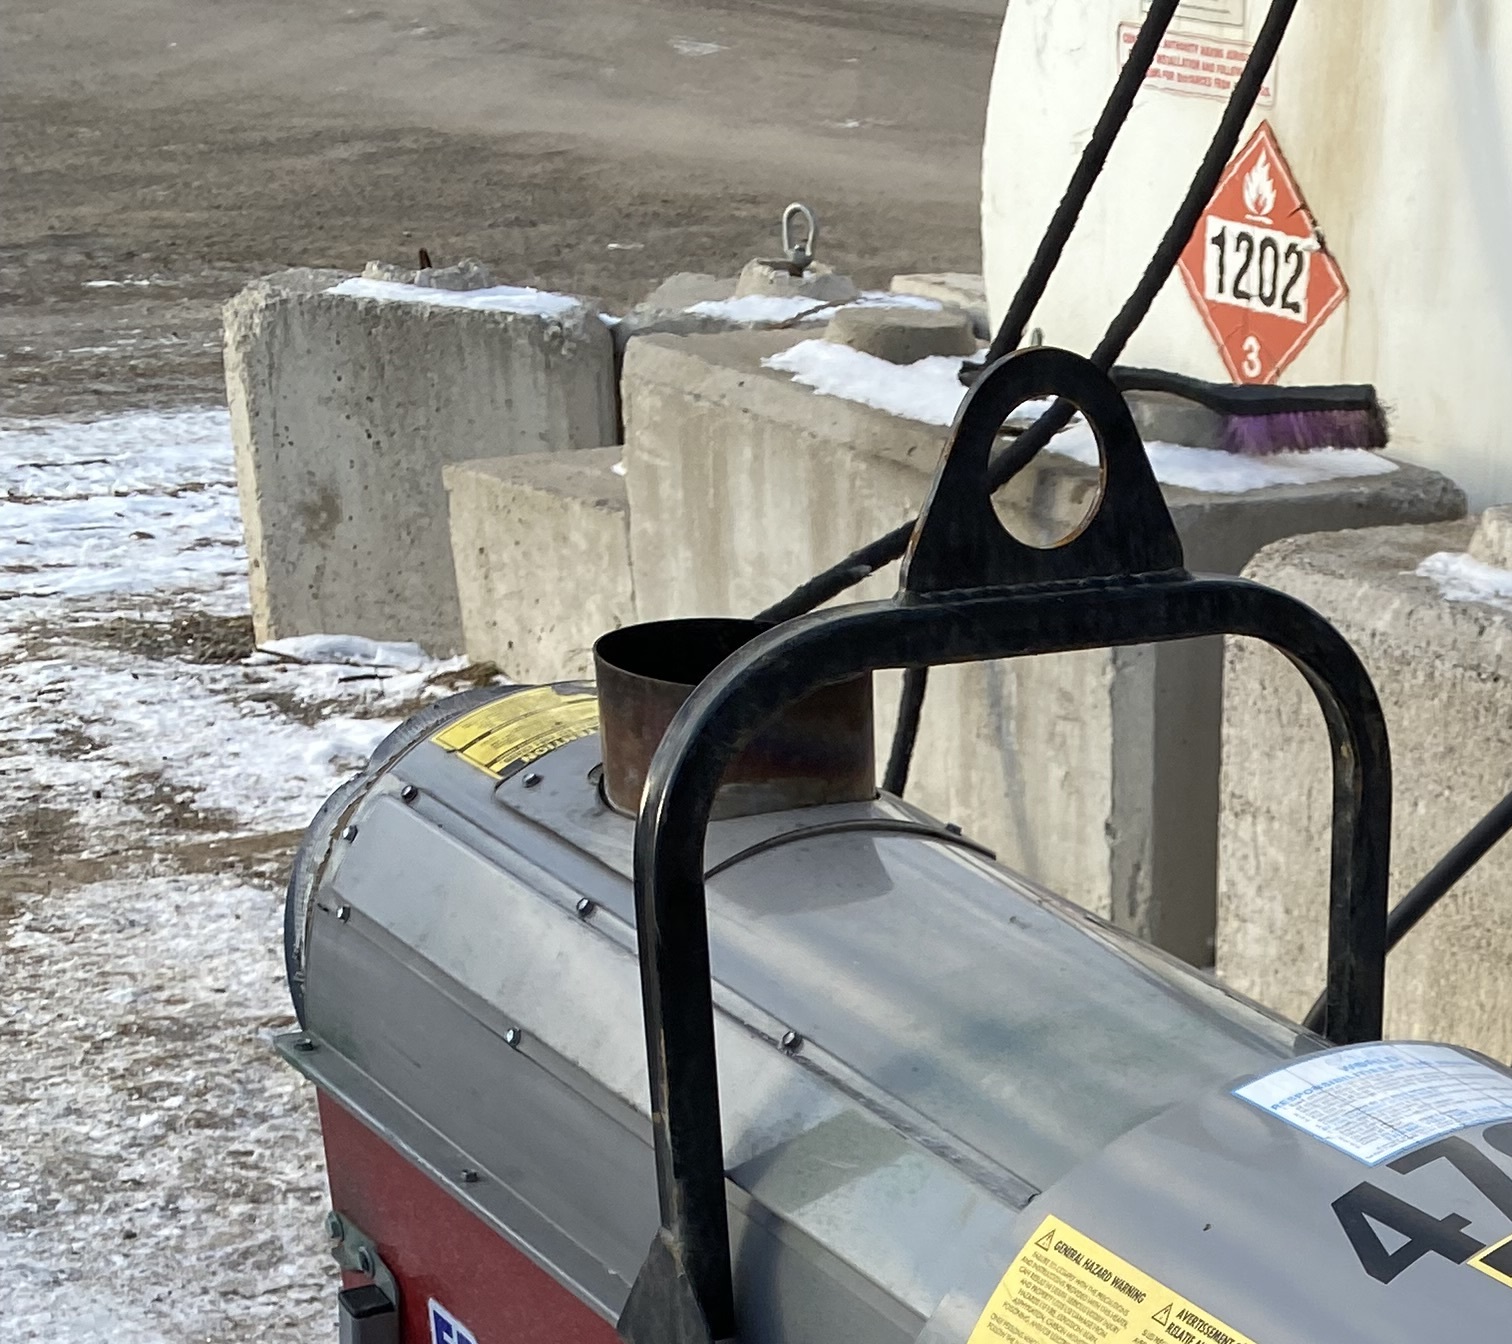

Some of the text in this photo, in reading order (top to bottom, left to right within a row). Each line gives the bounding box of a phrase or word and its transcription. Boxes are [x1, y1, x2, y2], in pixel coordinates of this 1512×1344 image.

[1210, 225, 1307, 314] 1202
[1239, 335, 1261, 378] 3
[1054, 1240, 1147, 1304] GENERAL HAZARD WARNING
